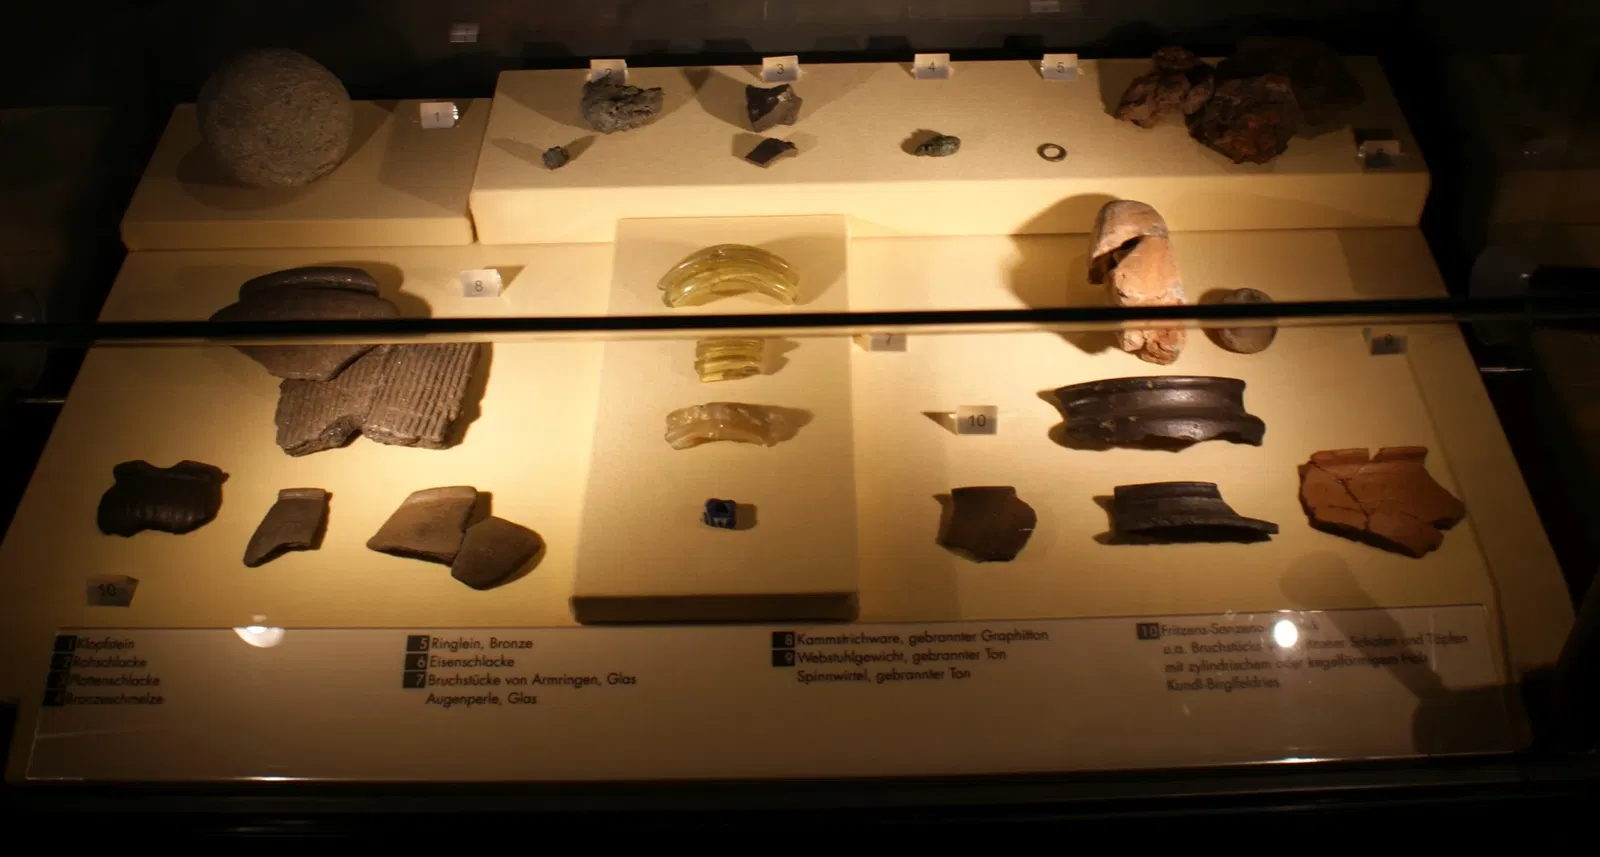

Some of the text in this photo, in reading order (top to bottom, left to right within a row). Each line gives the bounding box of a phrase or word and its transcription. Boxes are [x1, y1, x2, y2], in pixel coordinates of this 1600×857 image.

[776, 63, 784, 75] 3
[928, 62, 936, 73] 4
[1056, 62, 1065, 73] 5
[475, 281, 483, 292] 8
[968, 414, 987, 427] 10
[97, 584, 117, 598] 10
[77, 636, 135, 652] Klopfstein
[431, 637, 485, 653] Ringlein,
[490, 636, 533, 649] Bronze
[797, 632, 904, 647] Kammstrichware,
[909, 631, 976, 647] gebrannter
[430, 655, 515, 668] Eisenschlacke
[797, 650, 908, 666] Webstuhlgewicht,
[912, 649, 980, 666] gebrannter
[986, 648, 1006, 661] Ton
[1165, 661, 1184, 673] mit
[428, 673, 500, 687] Bruchstücke
[505, 676, 527, 686] von
[532, 672, 602, 689] Armringen,
[607, 672, 637, 686] Glas
[876, 668, 945, 684] gebrannter
[950, 667, 971, 680] Ton
[426, 692, 537, 708] Augenperle, Glas
